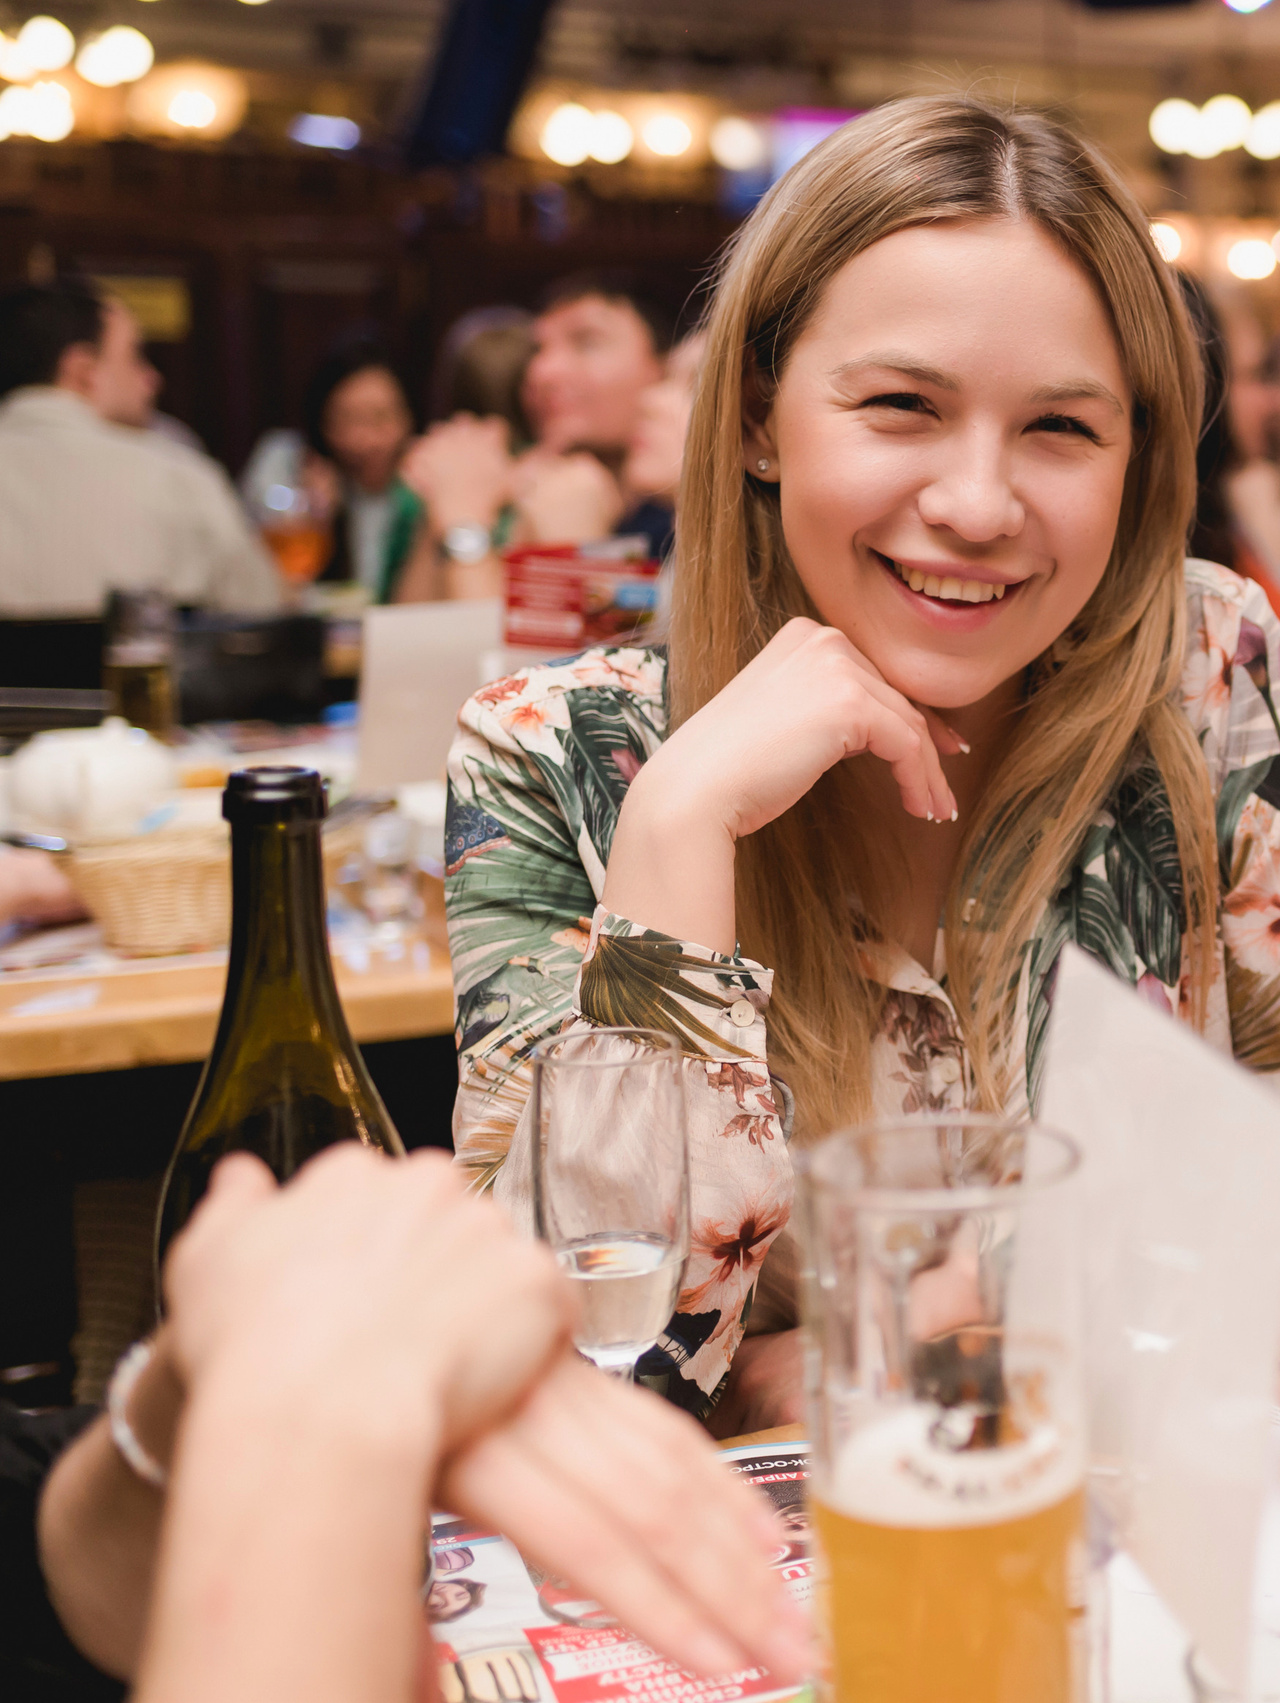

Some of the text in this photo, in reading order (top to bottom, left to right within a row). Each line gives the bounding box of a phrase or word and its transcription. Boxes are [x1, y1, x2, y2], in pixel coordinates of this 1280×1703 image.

[729, 1459, 813, 1474] ОК-ОСТРО
[743, 1472, 797, 1485] АПРЕЛ
[436, 1536, 457, 1545] 29
[578, 1650, 652, 1671] ОВНОЕ
[598, 1660, 680, 1687] РАСТУ
